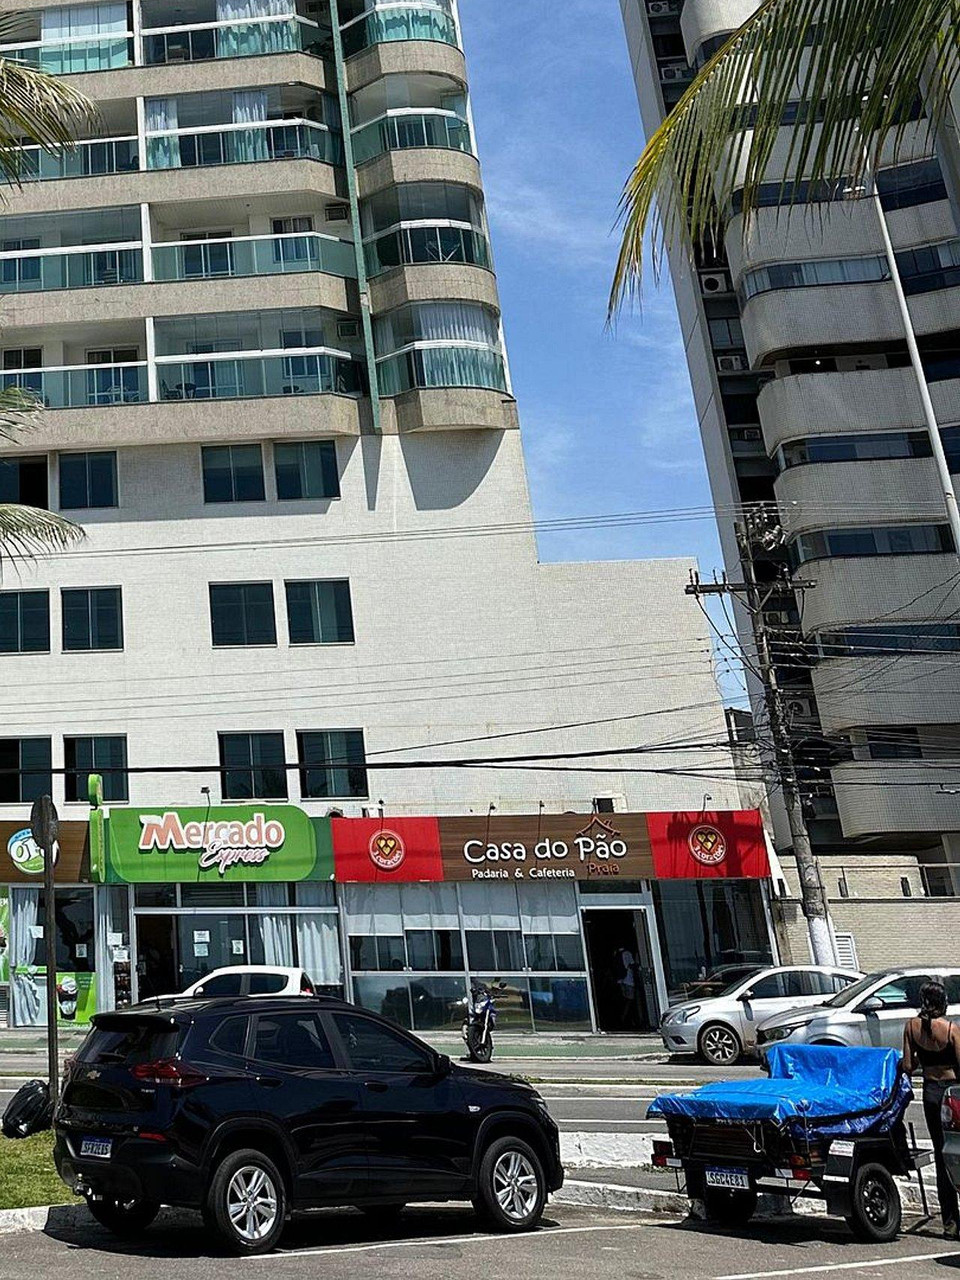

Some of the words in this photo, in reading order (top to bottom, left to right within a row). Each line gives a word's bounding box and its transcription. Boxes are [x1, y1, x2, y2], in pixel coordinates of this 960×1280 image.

[139, 811, 285, 850] Mercado
[198, 839, 271, 873] Express
[463, 839, 526, 863] Casa
[534, 838, 568, 859] do
[574, 833, 627, 861] Pão
[471, 868, 509, 879] Padaria
[514, 867, 524, 878] &
[529, 867, 576, 878] Cafeteria
[588, 862, 620, 875] Praia
